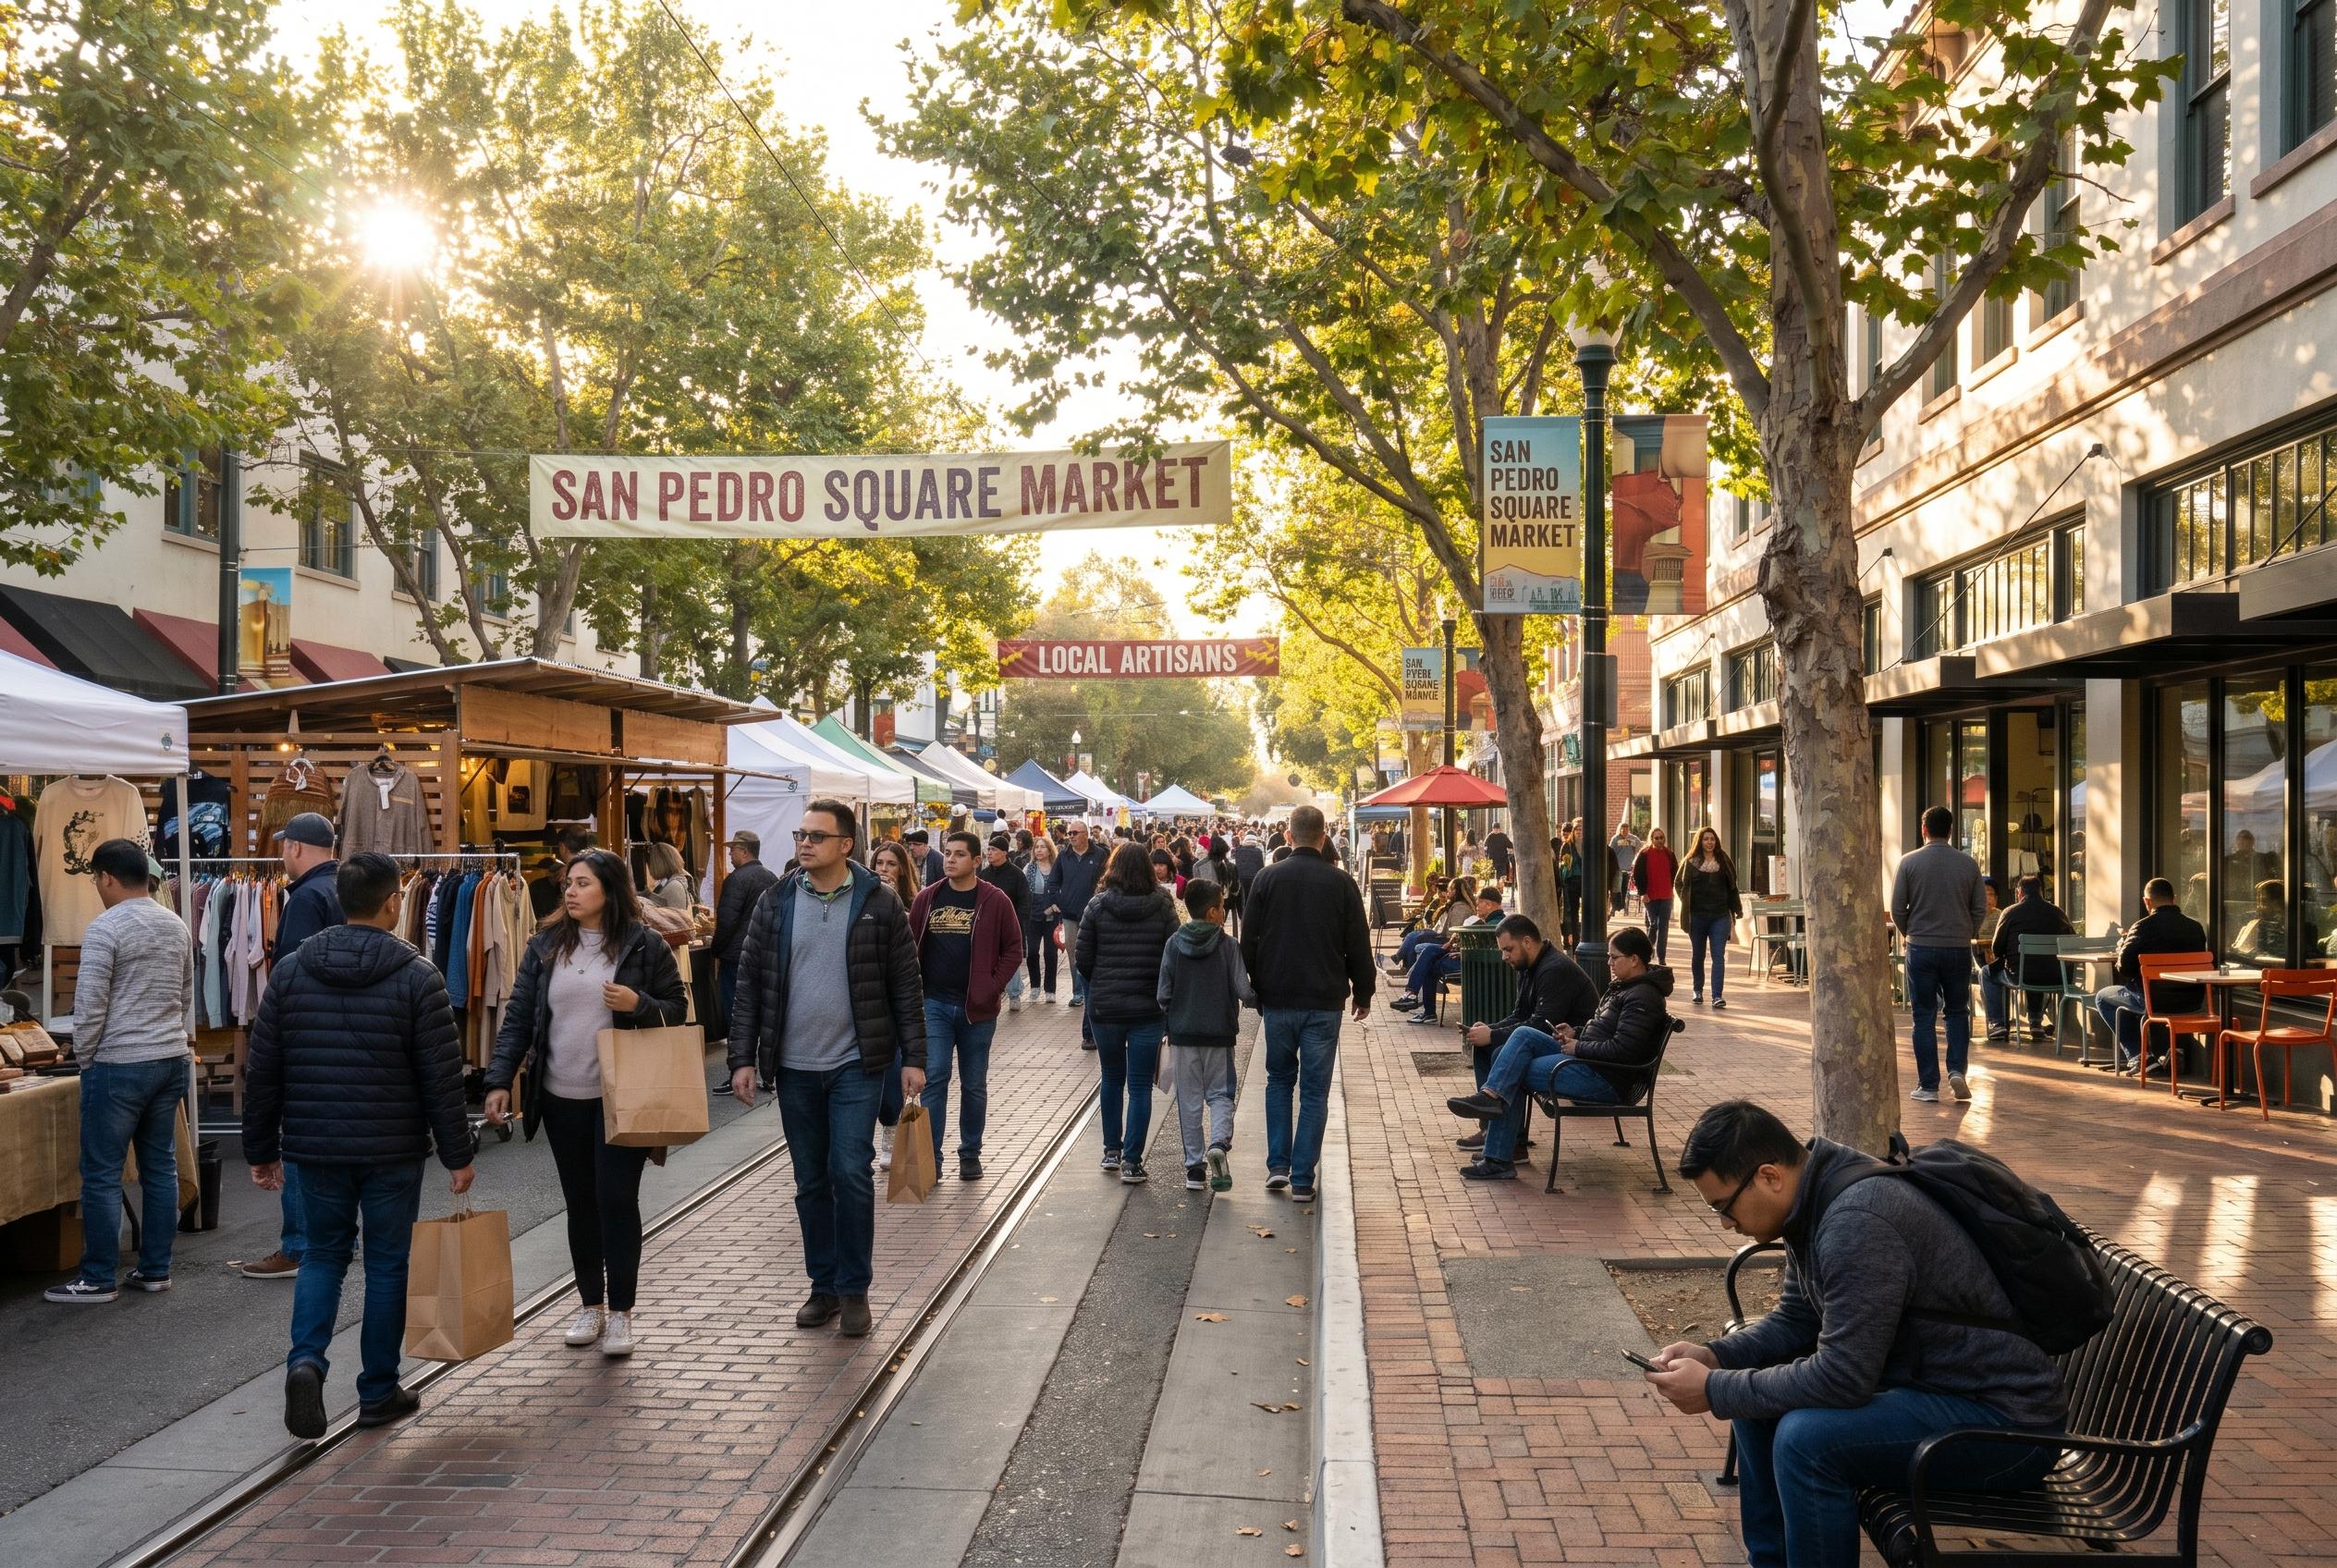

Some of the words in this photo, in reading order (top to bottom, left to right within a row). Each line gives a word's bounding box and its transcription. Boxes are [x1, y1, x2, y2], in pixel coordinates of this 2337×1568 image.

[1490, 440, 1531, 463] SAN
[1490, 467, 1559, 492] PEDRO
[553, 470, 638, 521] SAN
[658, 470, 805, 522] PEDRO
[824, 468, 1001, 532] SQUARE
[1021, 457, 1208, 516] MARKET
[1490, 496, 1572, 523] SQUARE
[1490, 524, 1575, 547] MARKET
[1038, 645, 1111, 674] LOCAL
[1120, 643, 1237, 674] ARTISANS
